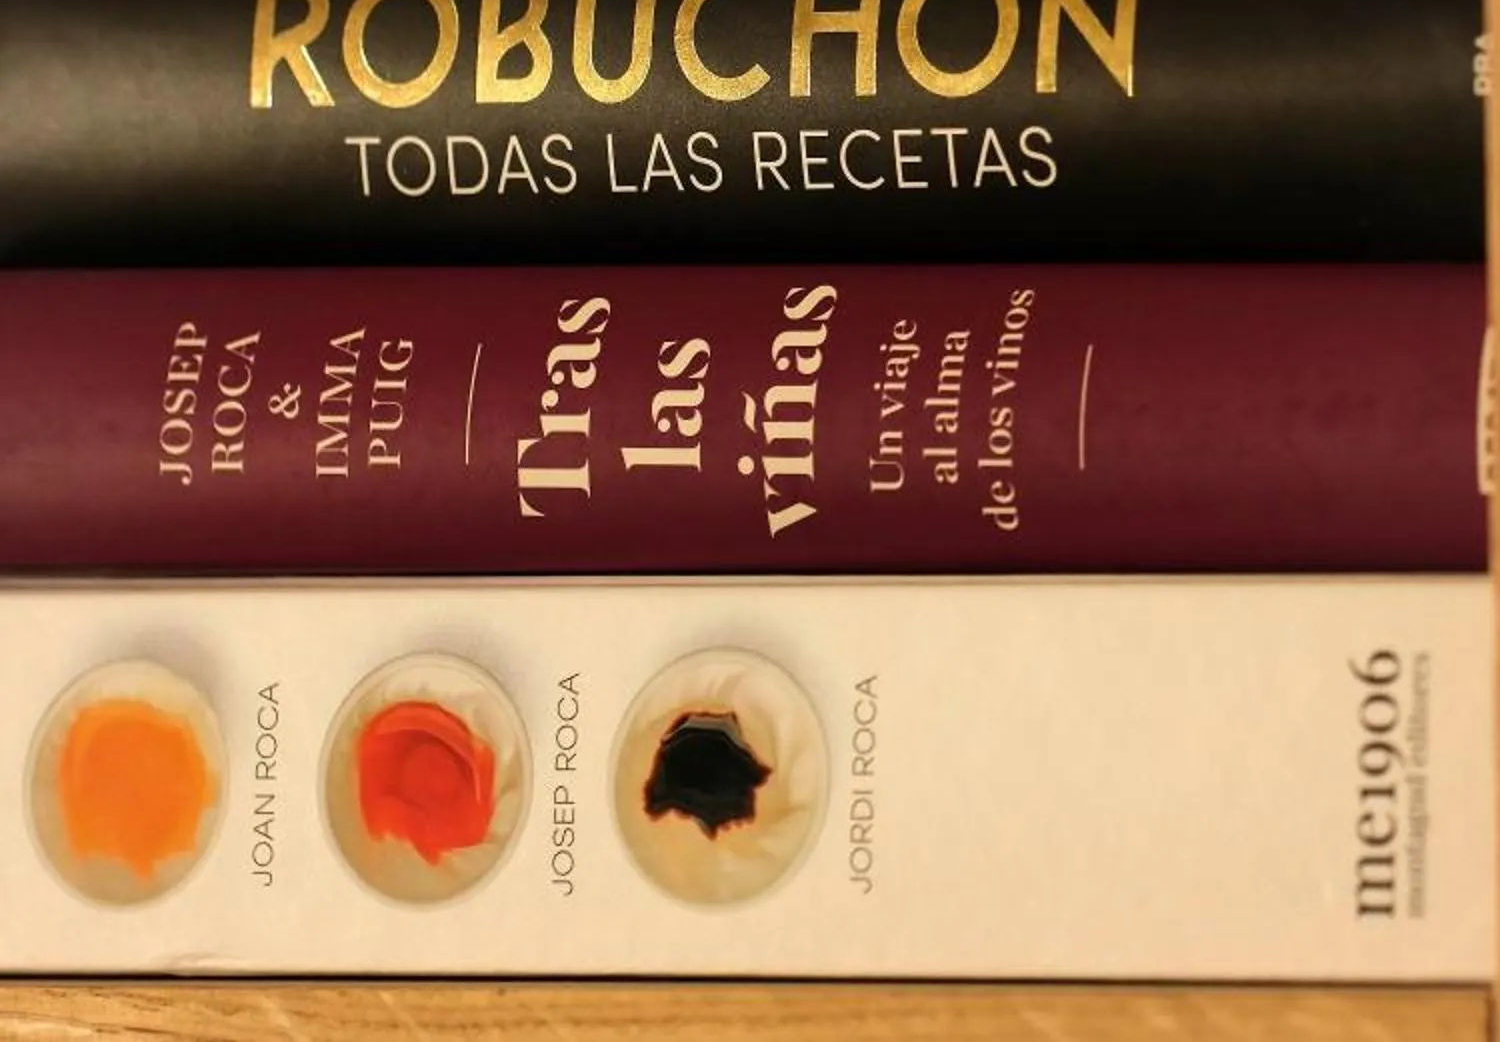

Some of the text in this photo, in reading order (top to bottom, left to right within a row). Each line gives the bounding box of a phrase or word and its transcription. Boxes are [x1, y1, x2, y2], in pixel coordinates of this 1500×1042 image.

[343, 125, 1058, 197] TODAS LAS RECETAS
[159, 321, 208, 487] JOSEP
[211, 331, 261, 475] ROCA
[267, 380, 302, 420] &
[315, 327, 367, 479] IMMA
[367, 338, 414, 469] PUIG
[516, 296, 612, 518] Tras
[620, 336, 712, 473] las
[736, 284, 839, 539] viñas
[868, 318, 922, 493] Un viaje
[921, 328, 971, 485] al alma
[976, 287, 1036, 532] de los vinos
[251, 681, 280, 888] JOAN ROCA
[550, 671, 581, 898] JOSEP ROCA
[848, 673, 879, 895] JORDI ROCA
